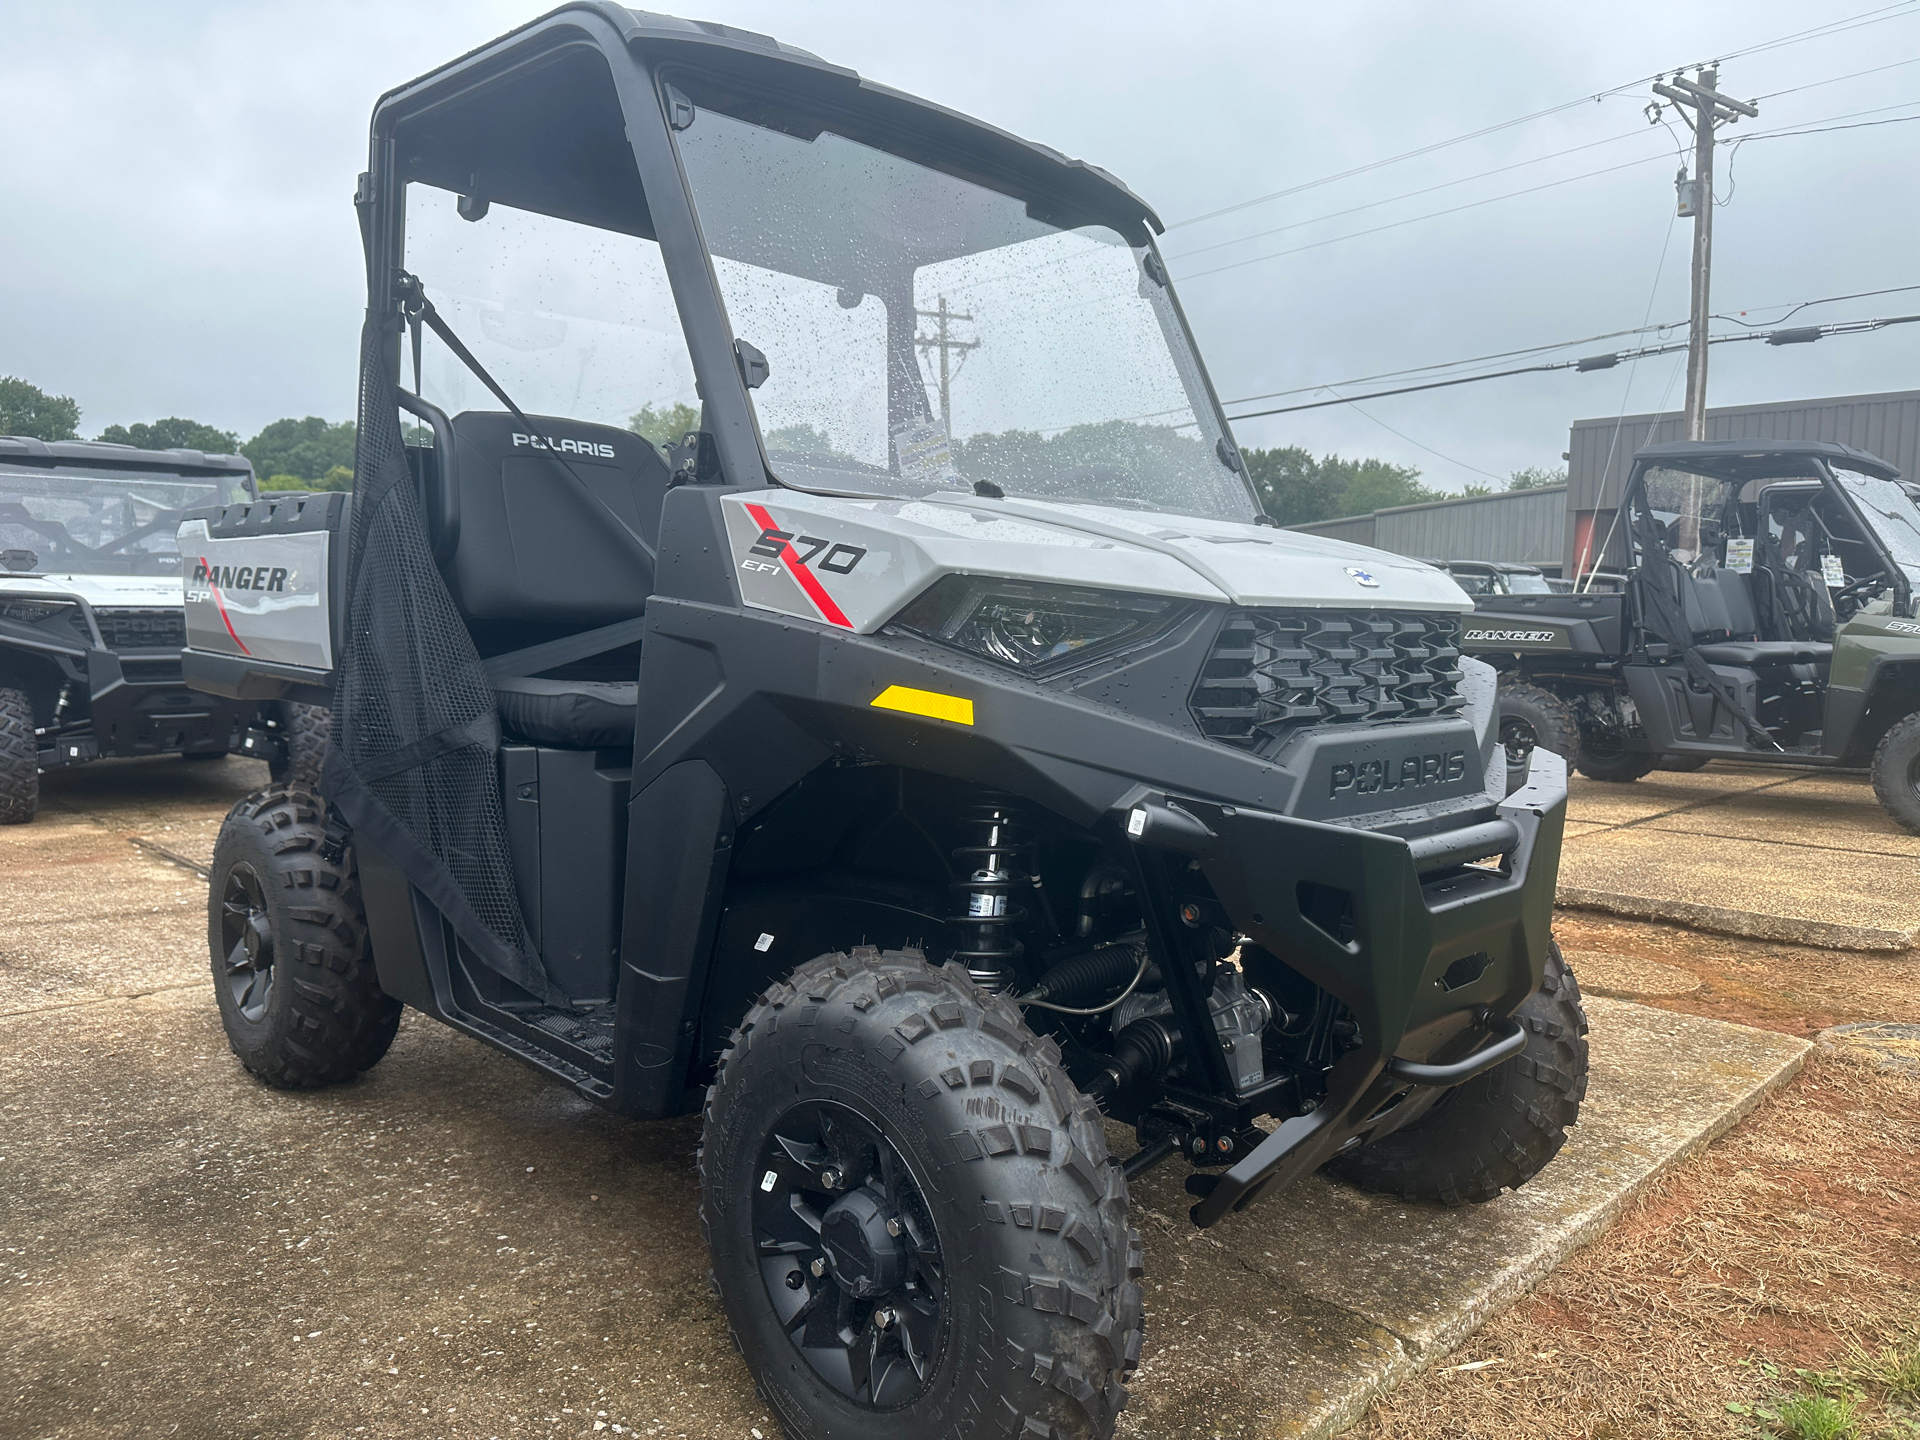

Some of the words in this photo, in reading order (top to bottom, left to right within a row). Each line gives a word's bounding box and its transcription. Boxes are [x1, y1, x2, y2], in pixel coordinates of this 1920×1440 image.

[512, 432, 615, 458] POLARIS
[749, 528, 867, 575] 570
[191, 564, 288, 592] RANGER
[740, 559, 781, 576] EFI
[186, 590, 211, 602] SP
[1464, 629, 1555, 642] RANGER
[1329, 750, 1466, 800] POLARIS
